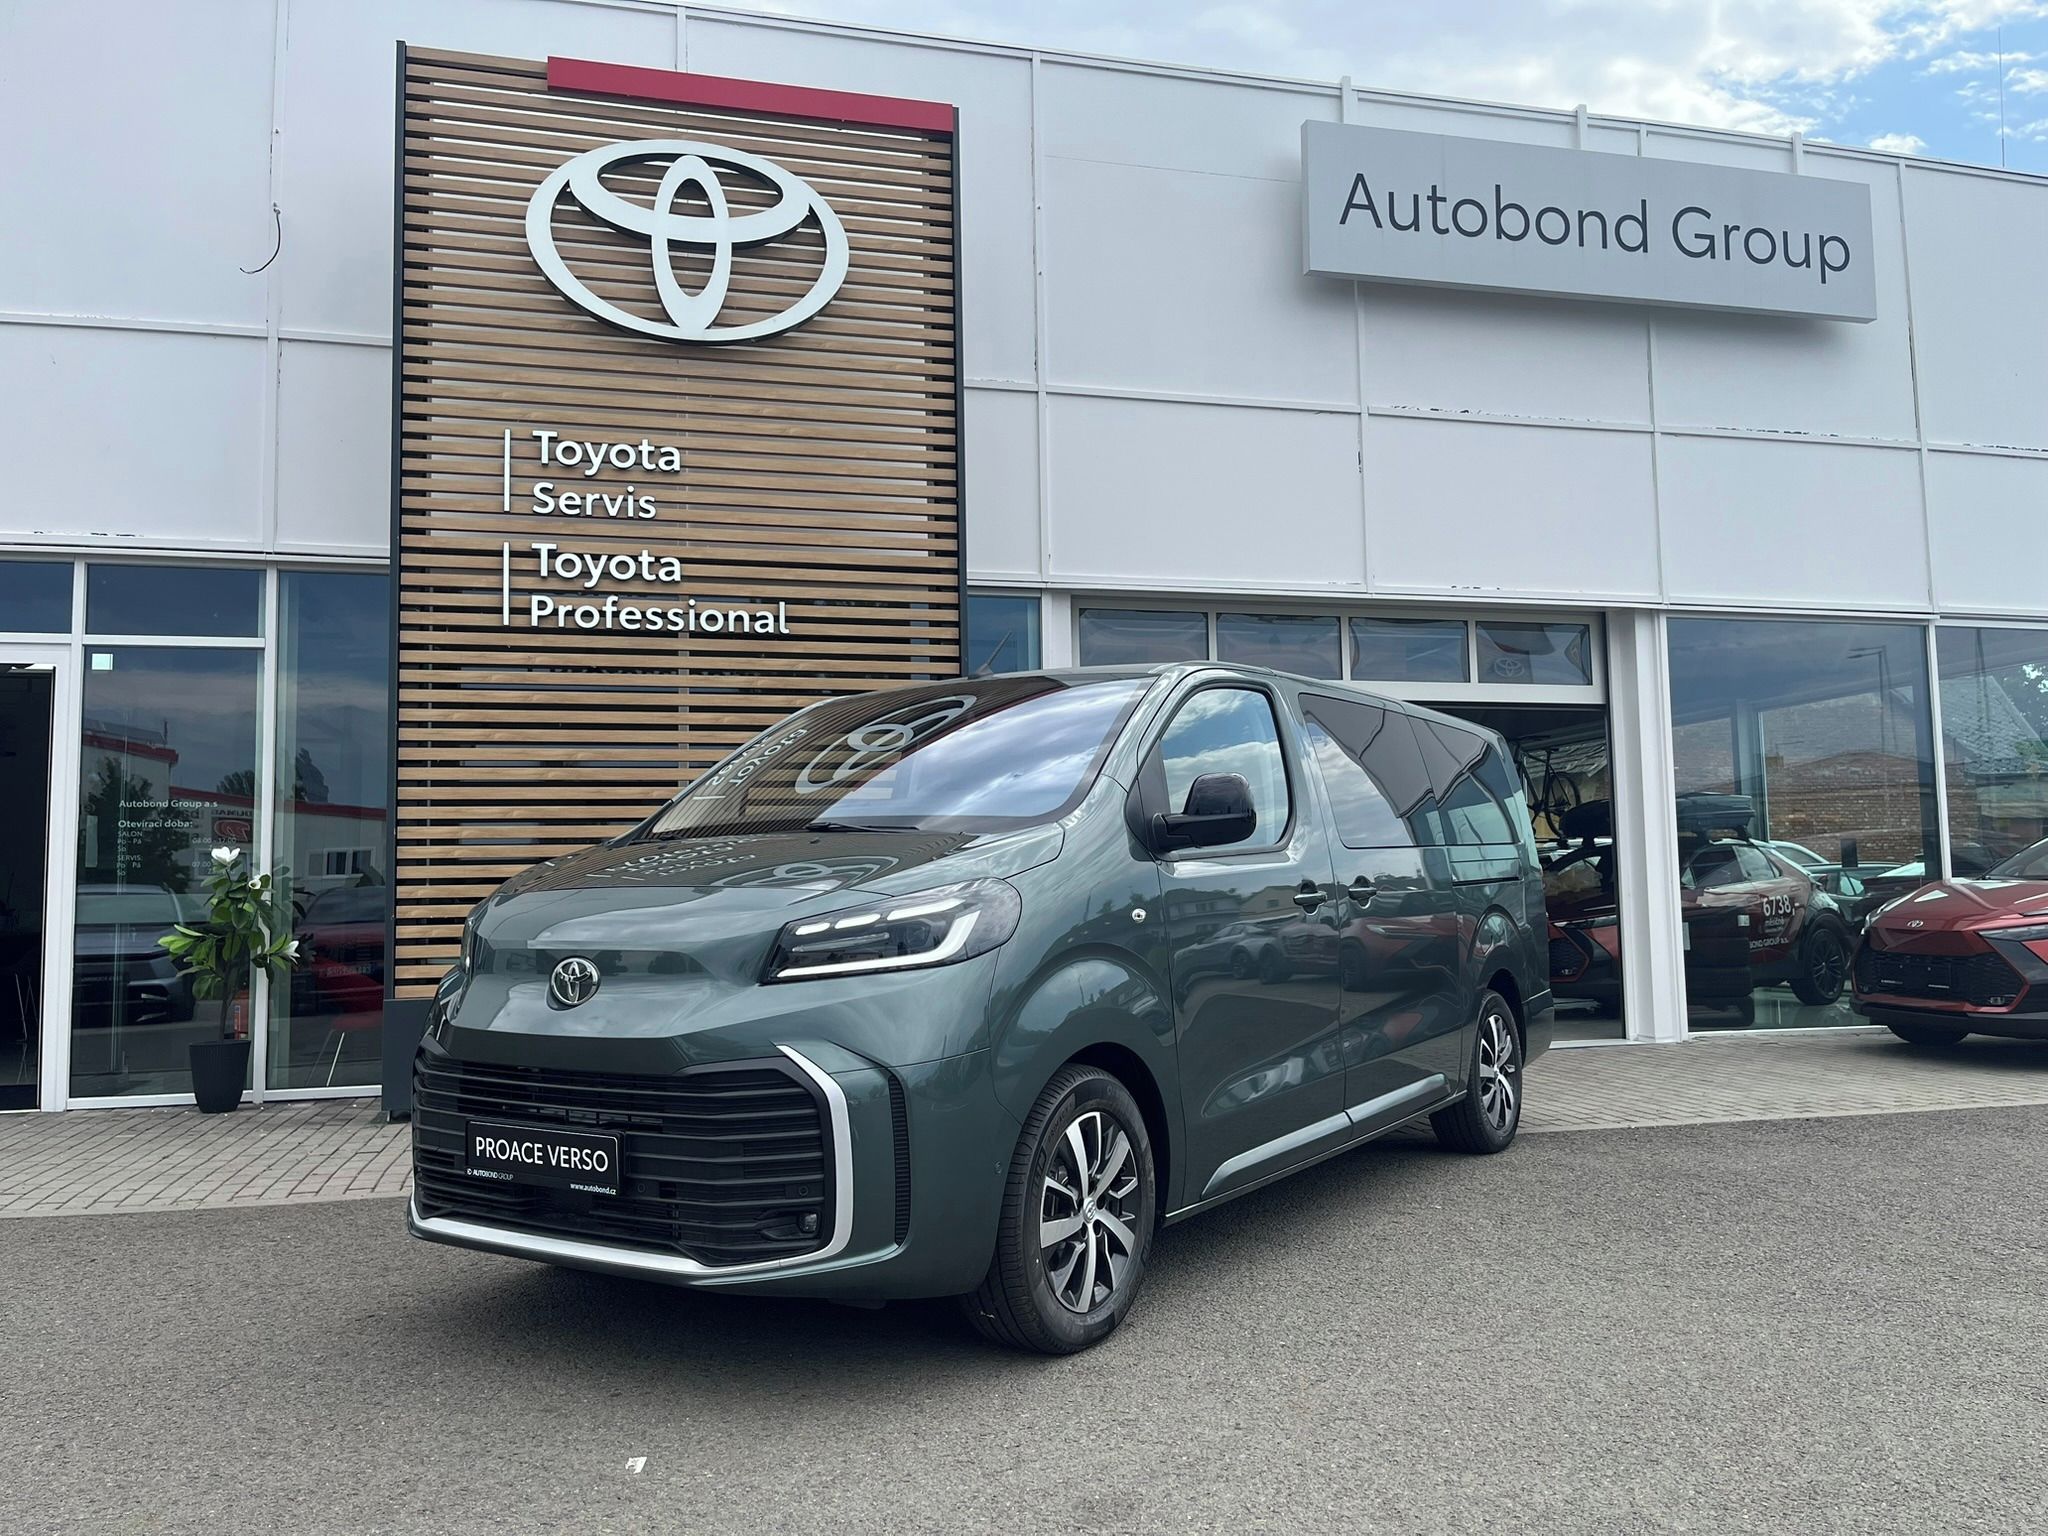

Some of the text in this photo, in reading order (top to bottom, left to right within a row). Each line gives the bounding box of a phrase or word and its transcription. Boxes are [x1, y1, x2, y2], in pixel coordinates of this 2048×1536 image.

[1338, 172, 1851, 285] Autobond Group
[531, 429, 682, 477] Toyota
[531, 481, 657, 519] Servis
[530, 542, 682, 589] Toyota
[530, 594, 791, 635] Professional
[118, 799, 169, 808] Autobond
[170, 800, 203, 810] Group
[475, 1136, 609, 1173] PROACE VERSO
[569, 1183, 617, 1196] www.autobond.cz
